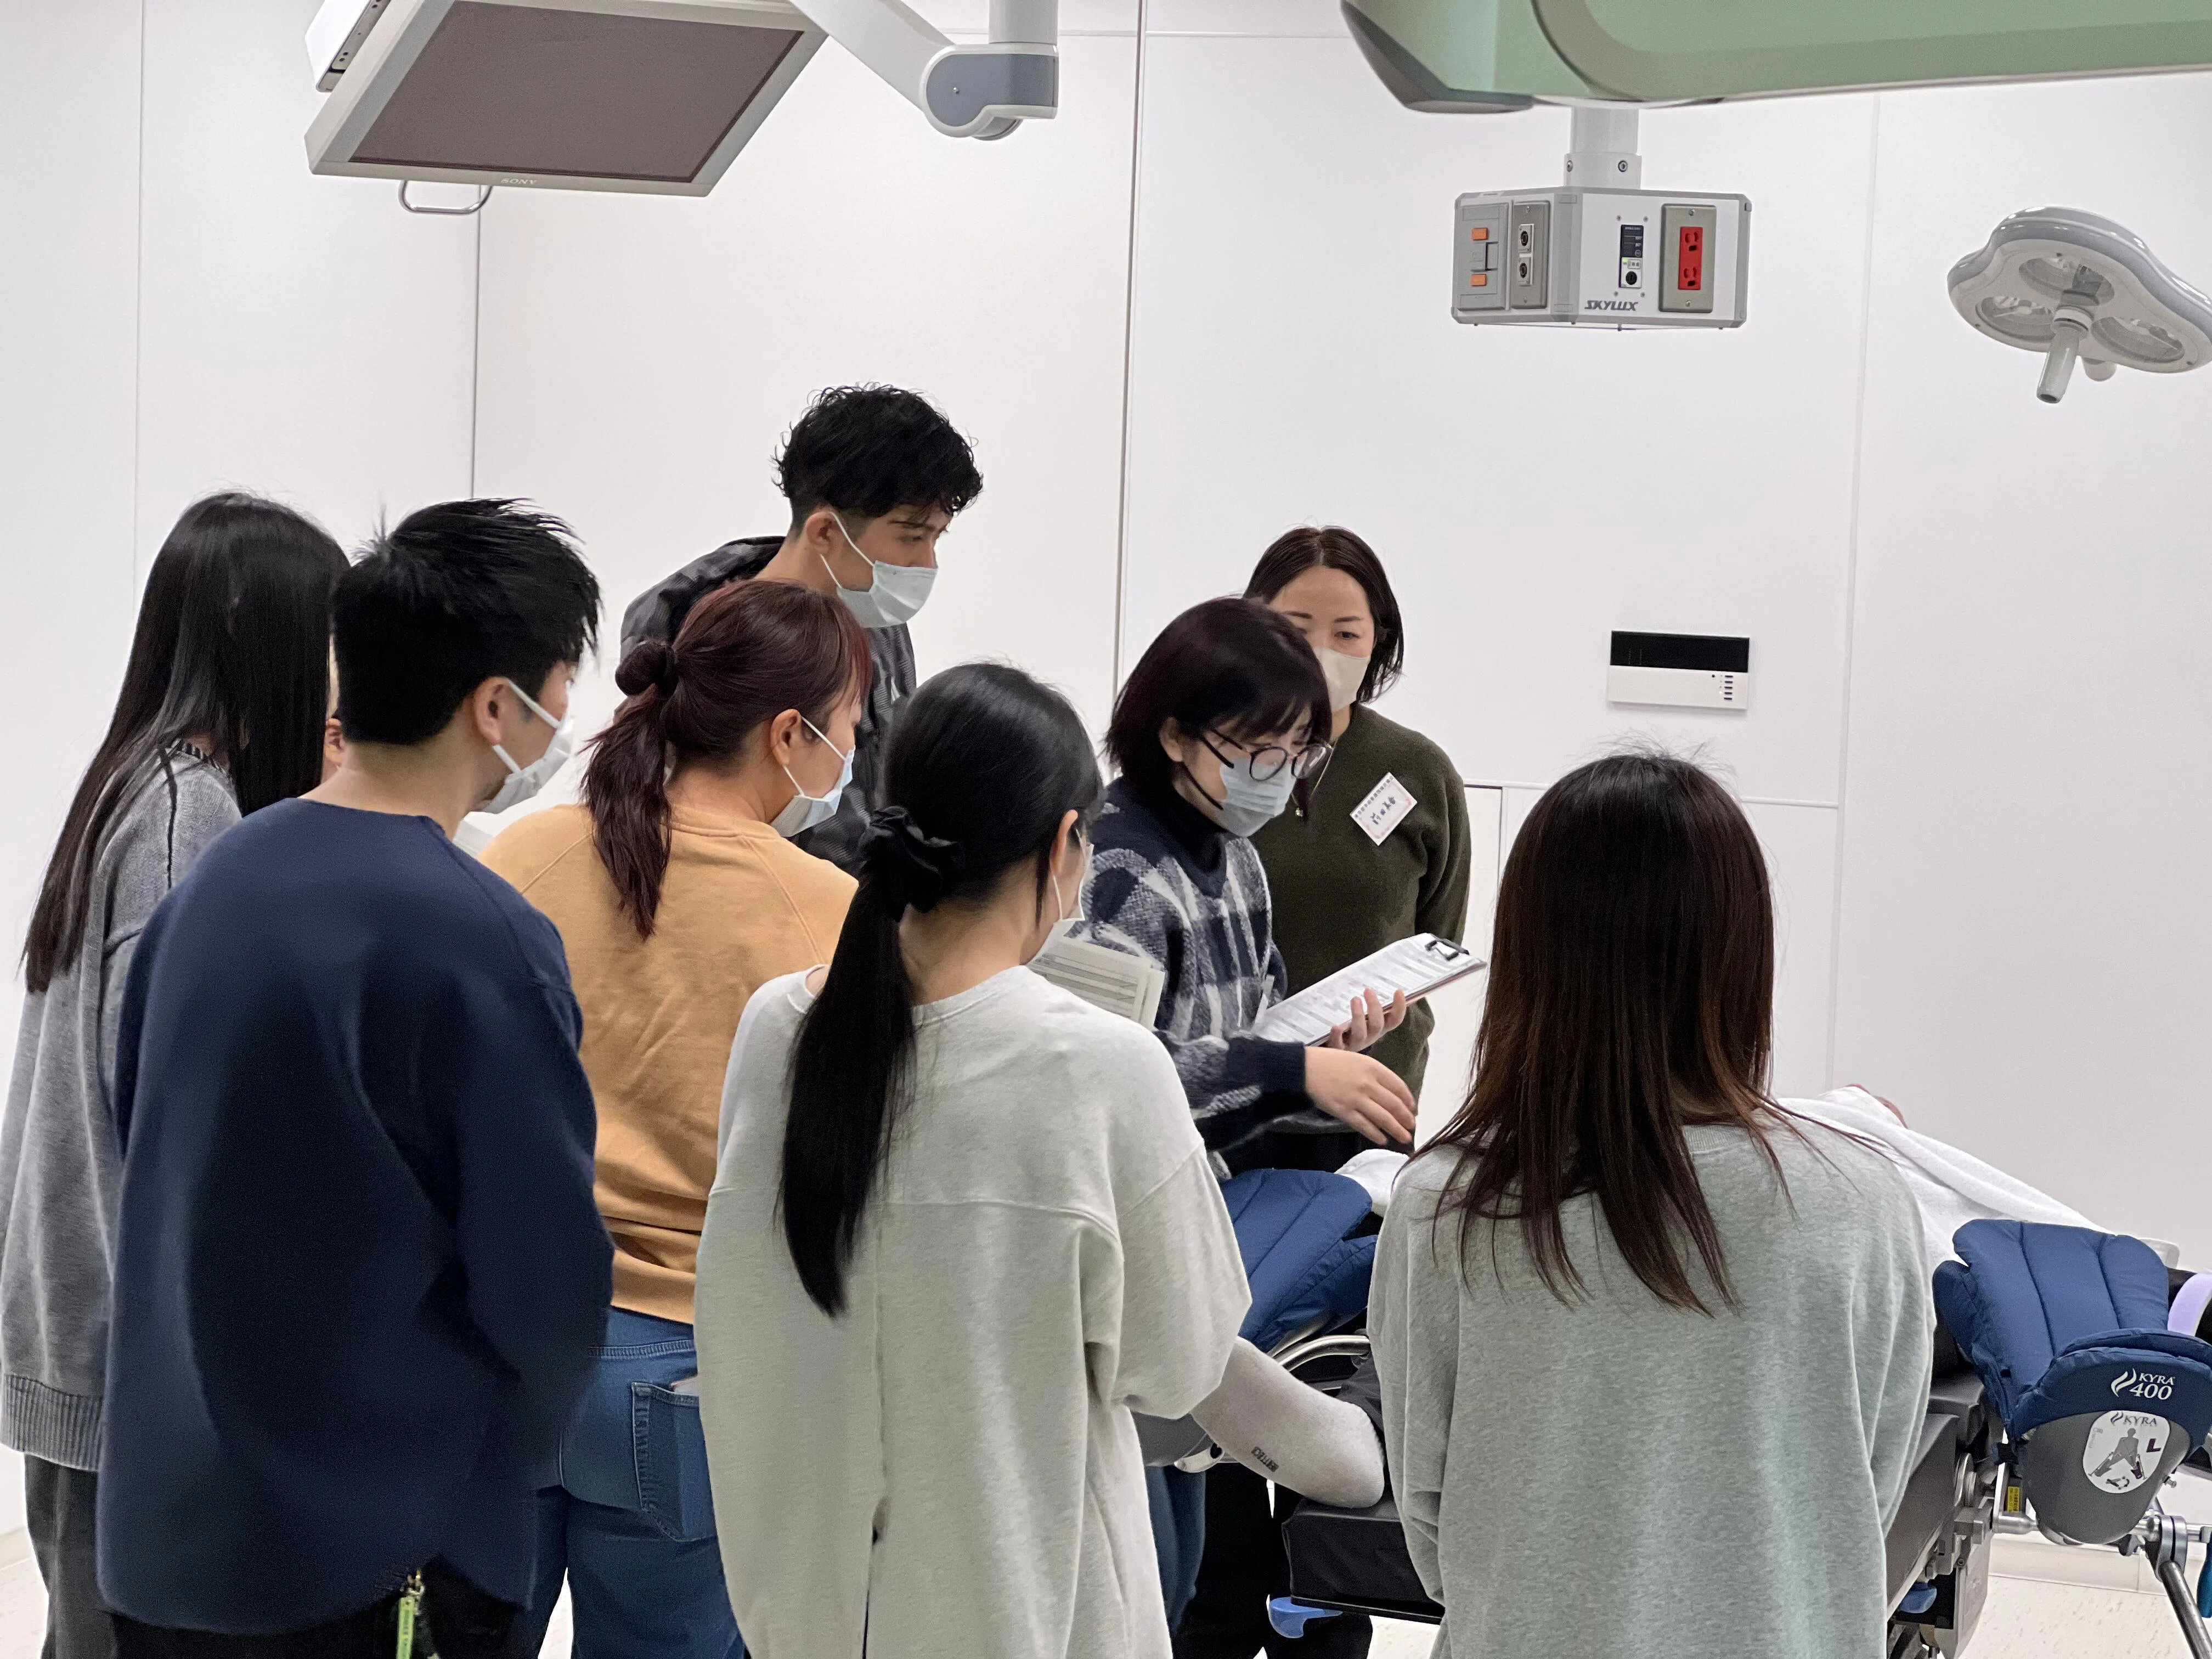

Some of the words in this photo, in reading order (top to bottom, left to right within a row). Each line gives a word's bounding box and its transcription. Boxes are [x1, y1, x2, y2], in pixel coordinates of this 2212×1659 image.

[1584, 300, 1639, 311] SKYLUX
[2138, 1373, 2174, 1385] KYRA
[2129, 1383, 2172, 1400] 400
[2123, 1415, 2157, 1426] KYRA
[2146, 1438, 2162, 1453] L
